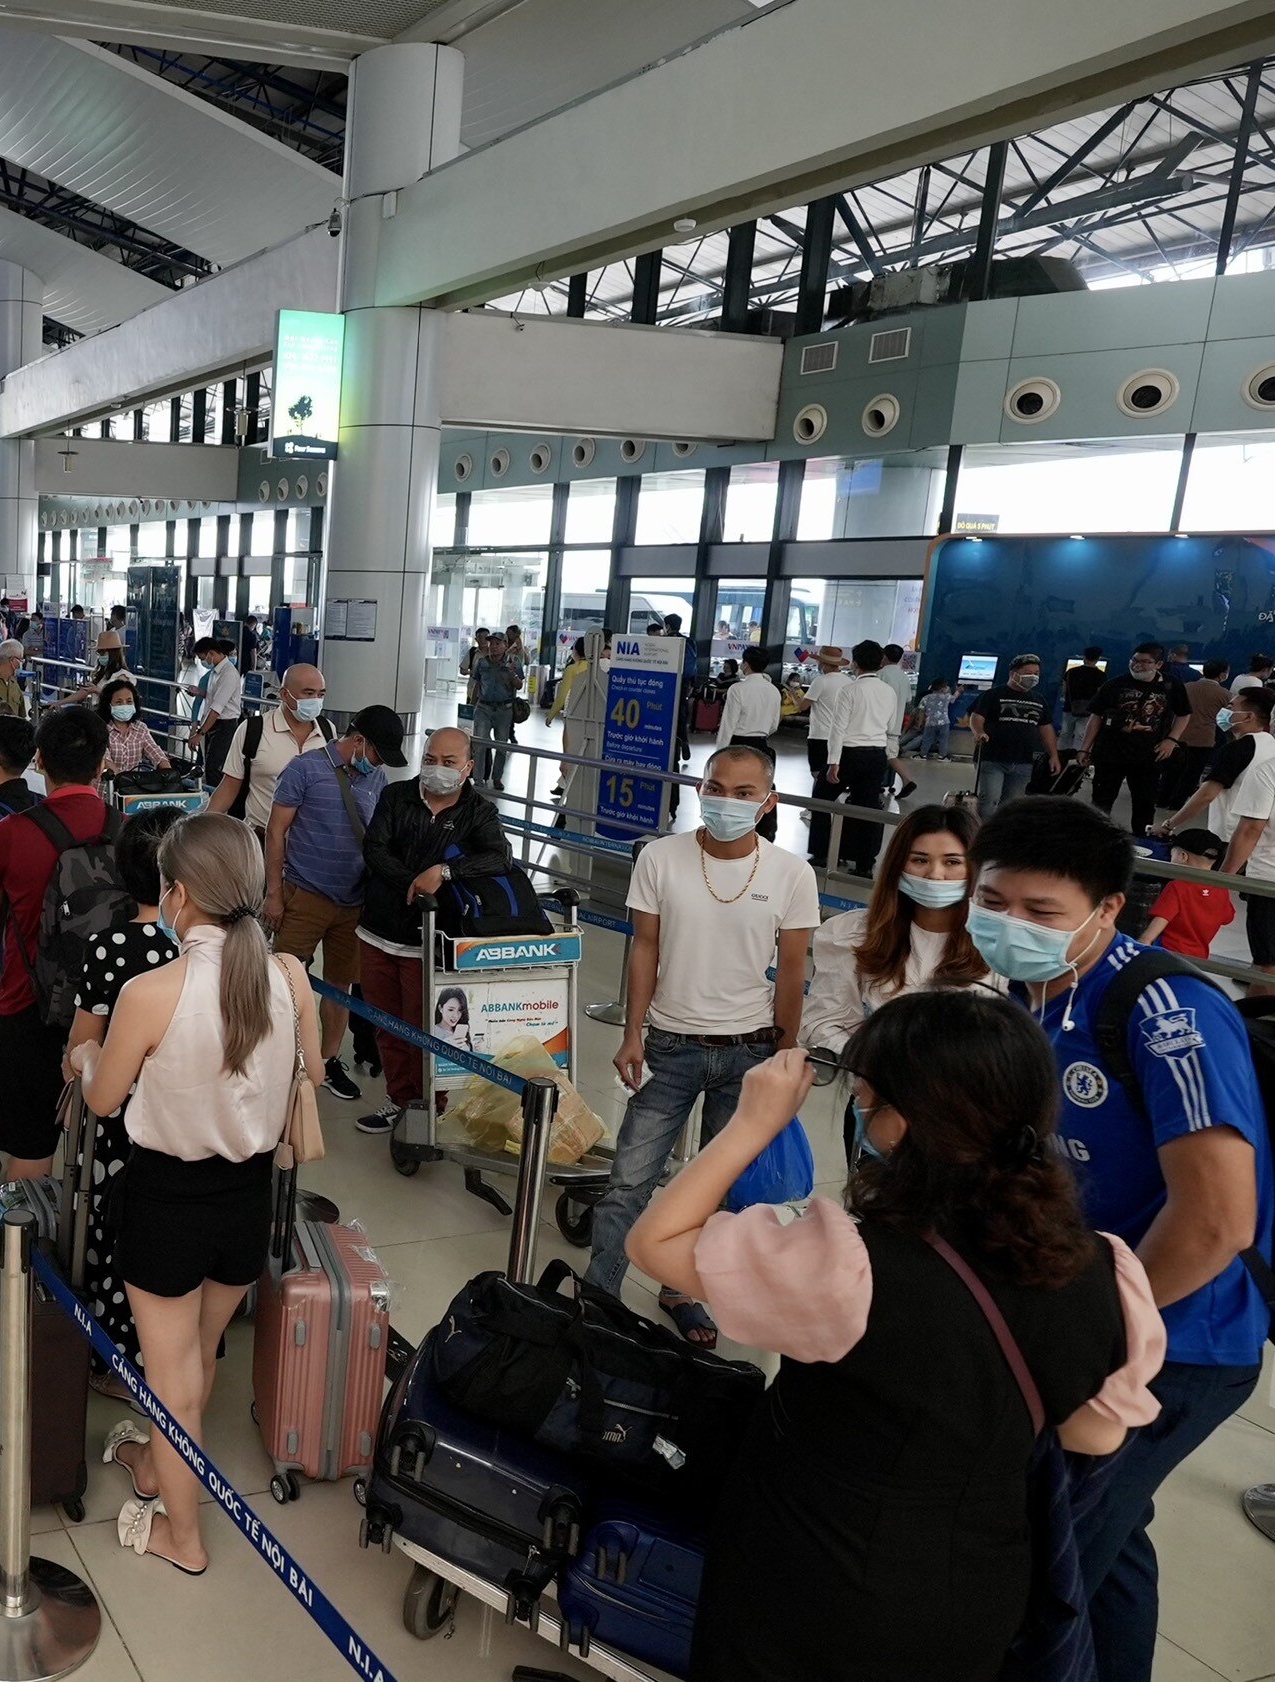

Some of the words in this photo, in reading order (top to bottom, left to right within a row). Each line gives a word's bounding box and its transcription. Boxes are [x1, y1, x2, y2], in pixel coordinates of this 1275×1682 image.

[1258, 610, 1275, 623] ĐẶ
[617, 641, 640, 656] NIA
[610, 697, 640, 729] 40
[606, 775, 634, 807] 15
[476, 943, 557, 961] ABBANK
[481, 1001, 559, 1013] ABBANKmobile
[74, 1303, 93, 1337] N.I.A
[111, 1353, 138, 1395] CẢNG
[138, 1389, 167, 1430] HÀNG
[167, 1424, 205, 1475] KHÔNG
[208, 1470, 242, 1520] QUỐC
[243, 1511, 262, 1541] TẾ
[261, 1534, 285, 1574] NỘI
[289, 1564, 314, 1607] BÀI
[347, 1634, 385, 1682] N.I.A
